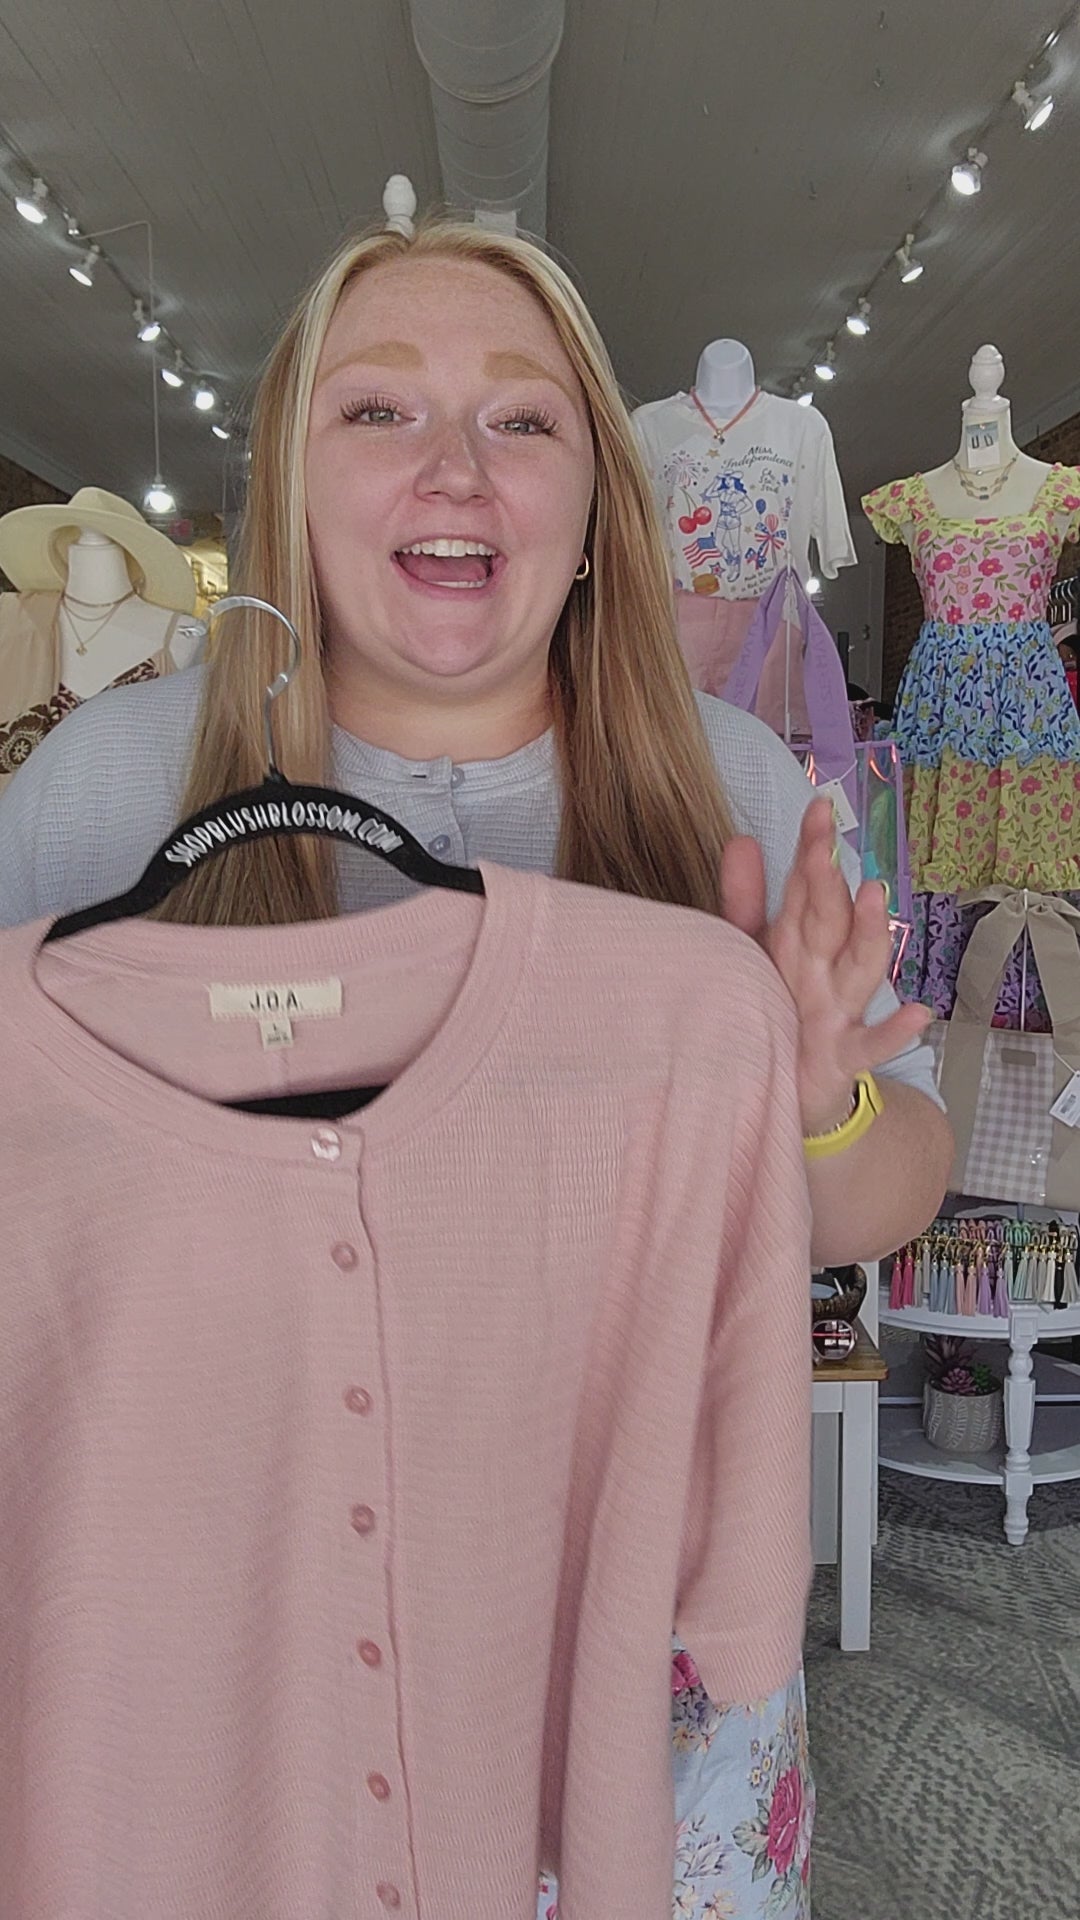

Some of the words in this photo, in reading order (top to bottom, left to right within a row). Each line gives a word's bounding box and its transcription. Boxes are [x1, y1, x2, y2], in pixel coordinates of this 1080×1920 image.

[748, 446, 773, 456] Miss
[721, 453, 794, 469] Independence
[249, 990, 299, 1011] JOA
